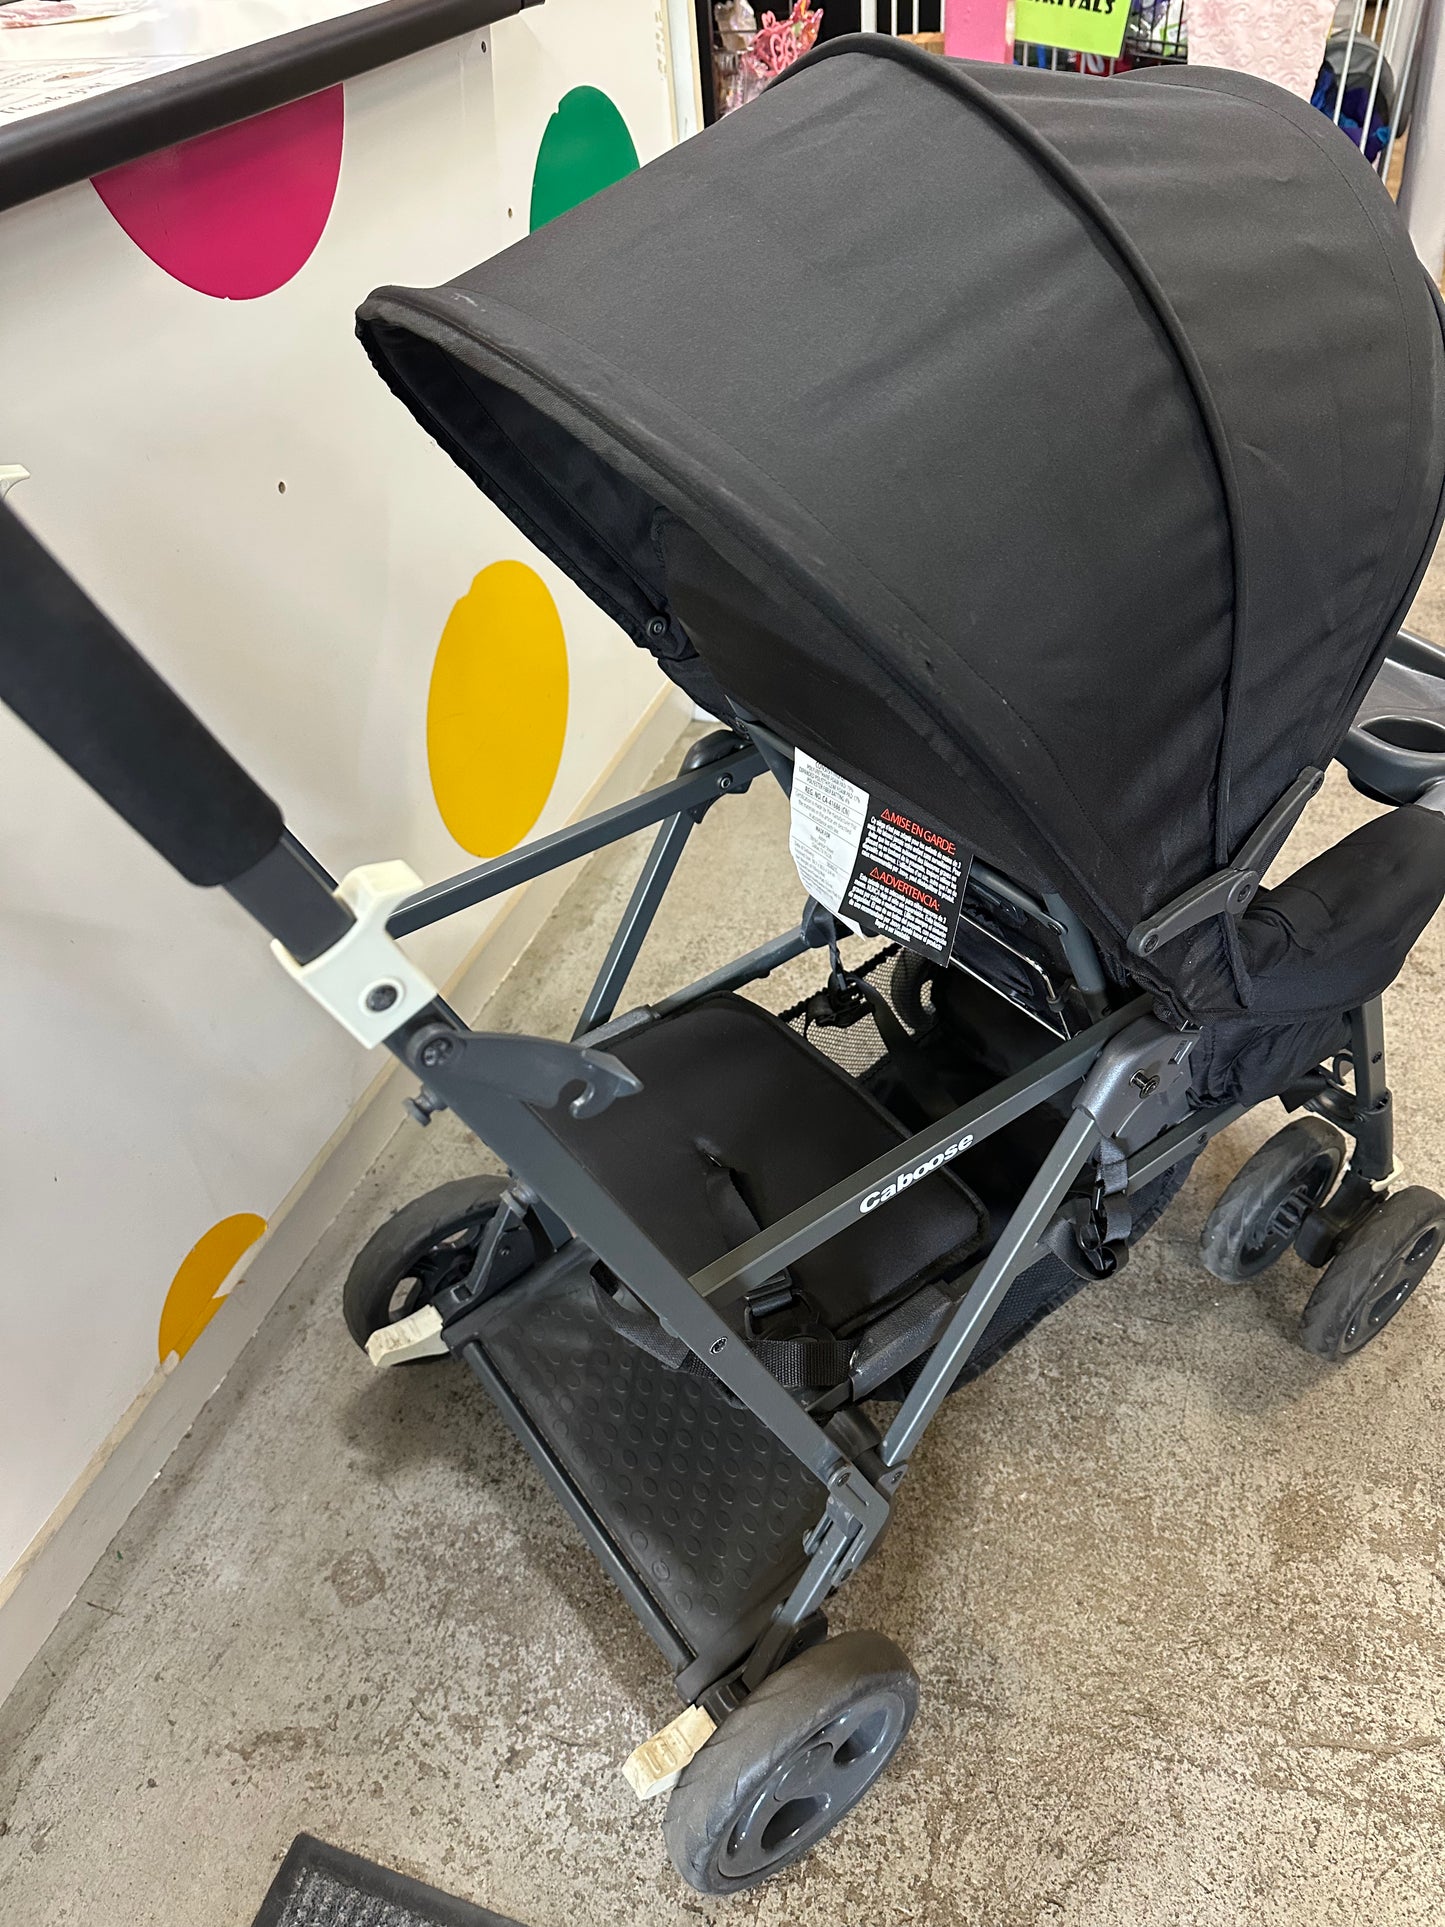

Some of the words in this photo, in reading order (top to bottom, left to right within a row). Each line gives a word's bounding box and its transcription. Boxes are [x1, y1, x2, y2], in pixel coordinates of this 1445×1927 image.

[889, 810, 912, 832] MISE
[910, 821, 924, 838] EN
[922, 828, 957, 857] GARDE:
[877, 870, 941, 912] ADVERTENCIA:
[859, 1134, 974, 1213] Caboose
